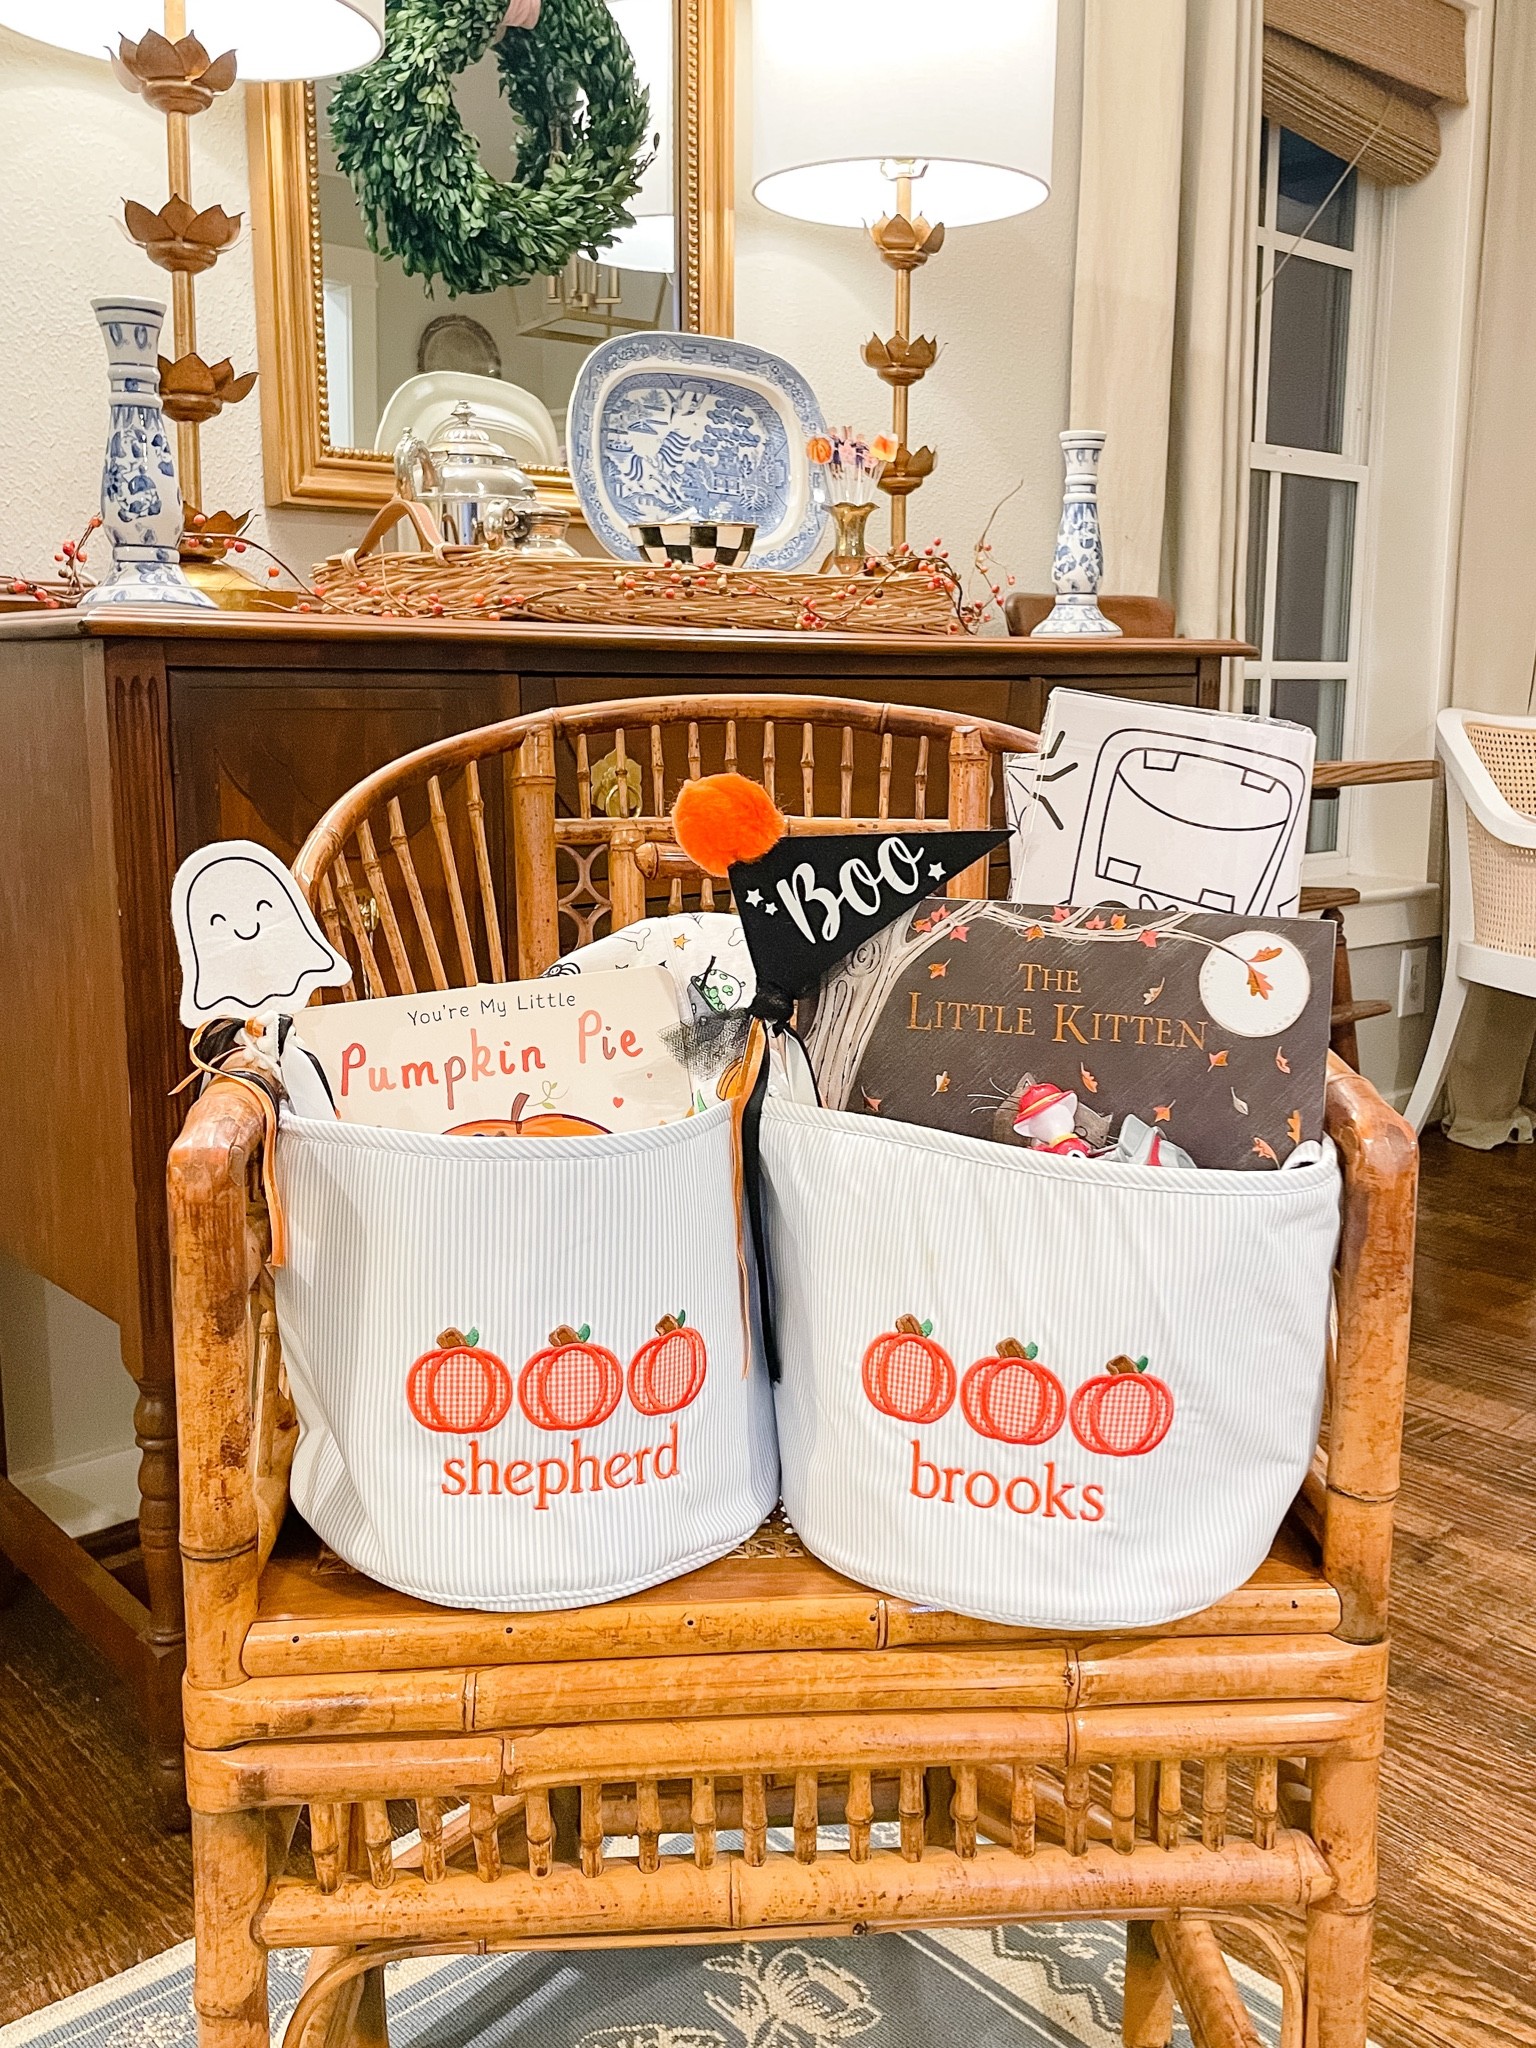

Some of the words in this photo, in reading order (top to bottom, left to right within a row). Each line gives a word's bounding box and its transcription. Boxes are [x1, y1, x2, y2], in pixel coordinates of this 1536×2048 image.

[407, 1003, 470, 1026] You're
[480, 1000, 508, 1018] My
[518, 991, 576, 1012] Little
[1018, 963, 1082, 994] THE
[907, 991, 1036, 1037] LITTLE
[1052, 1003, 1209, 1051] KITTEN
[340, 1028, 546, 1110] Pumpkin
[578, 1009, 644, 1065] Pie
[441, 1421, 680, 1510] shepherd
[909, 1438, 1106, 1522] brooks
